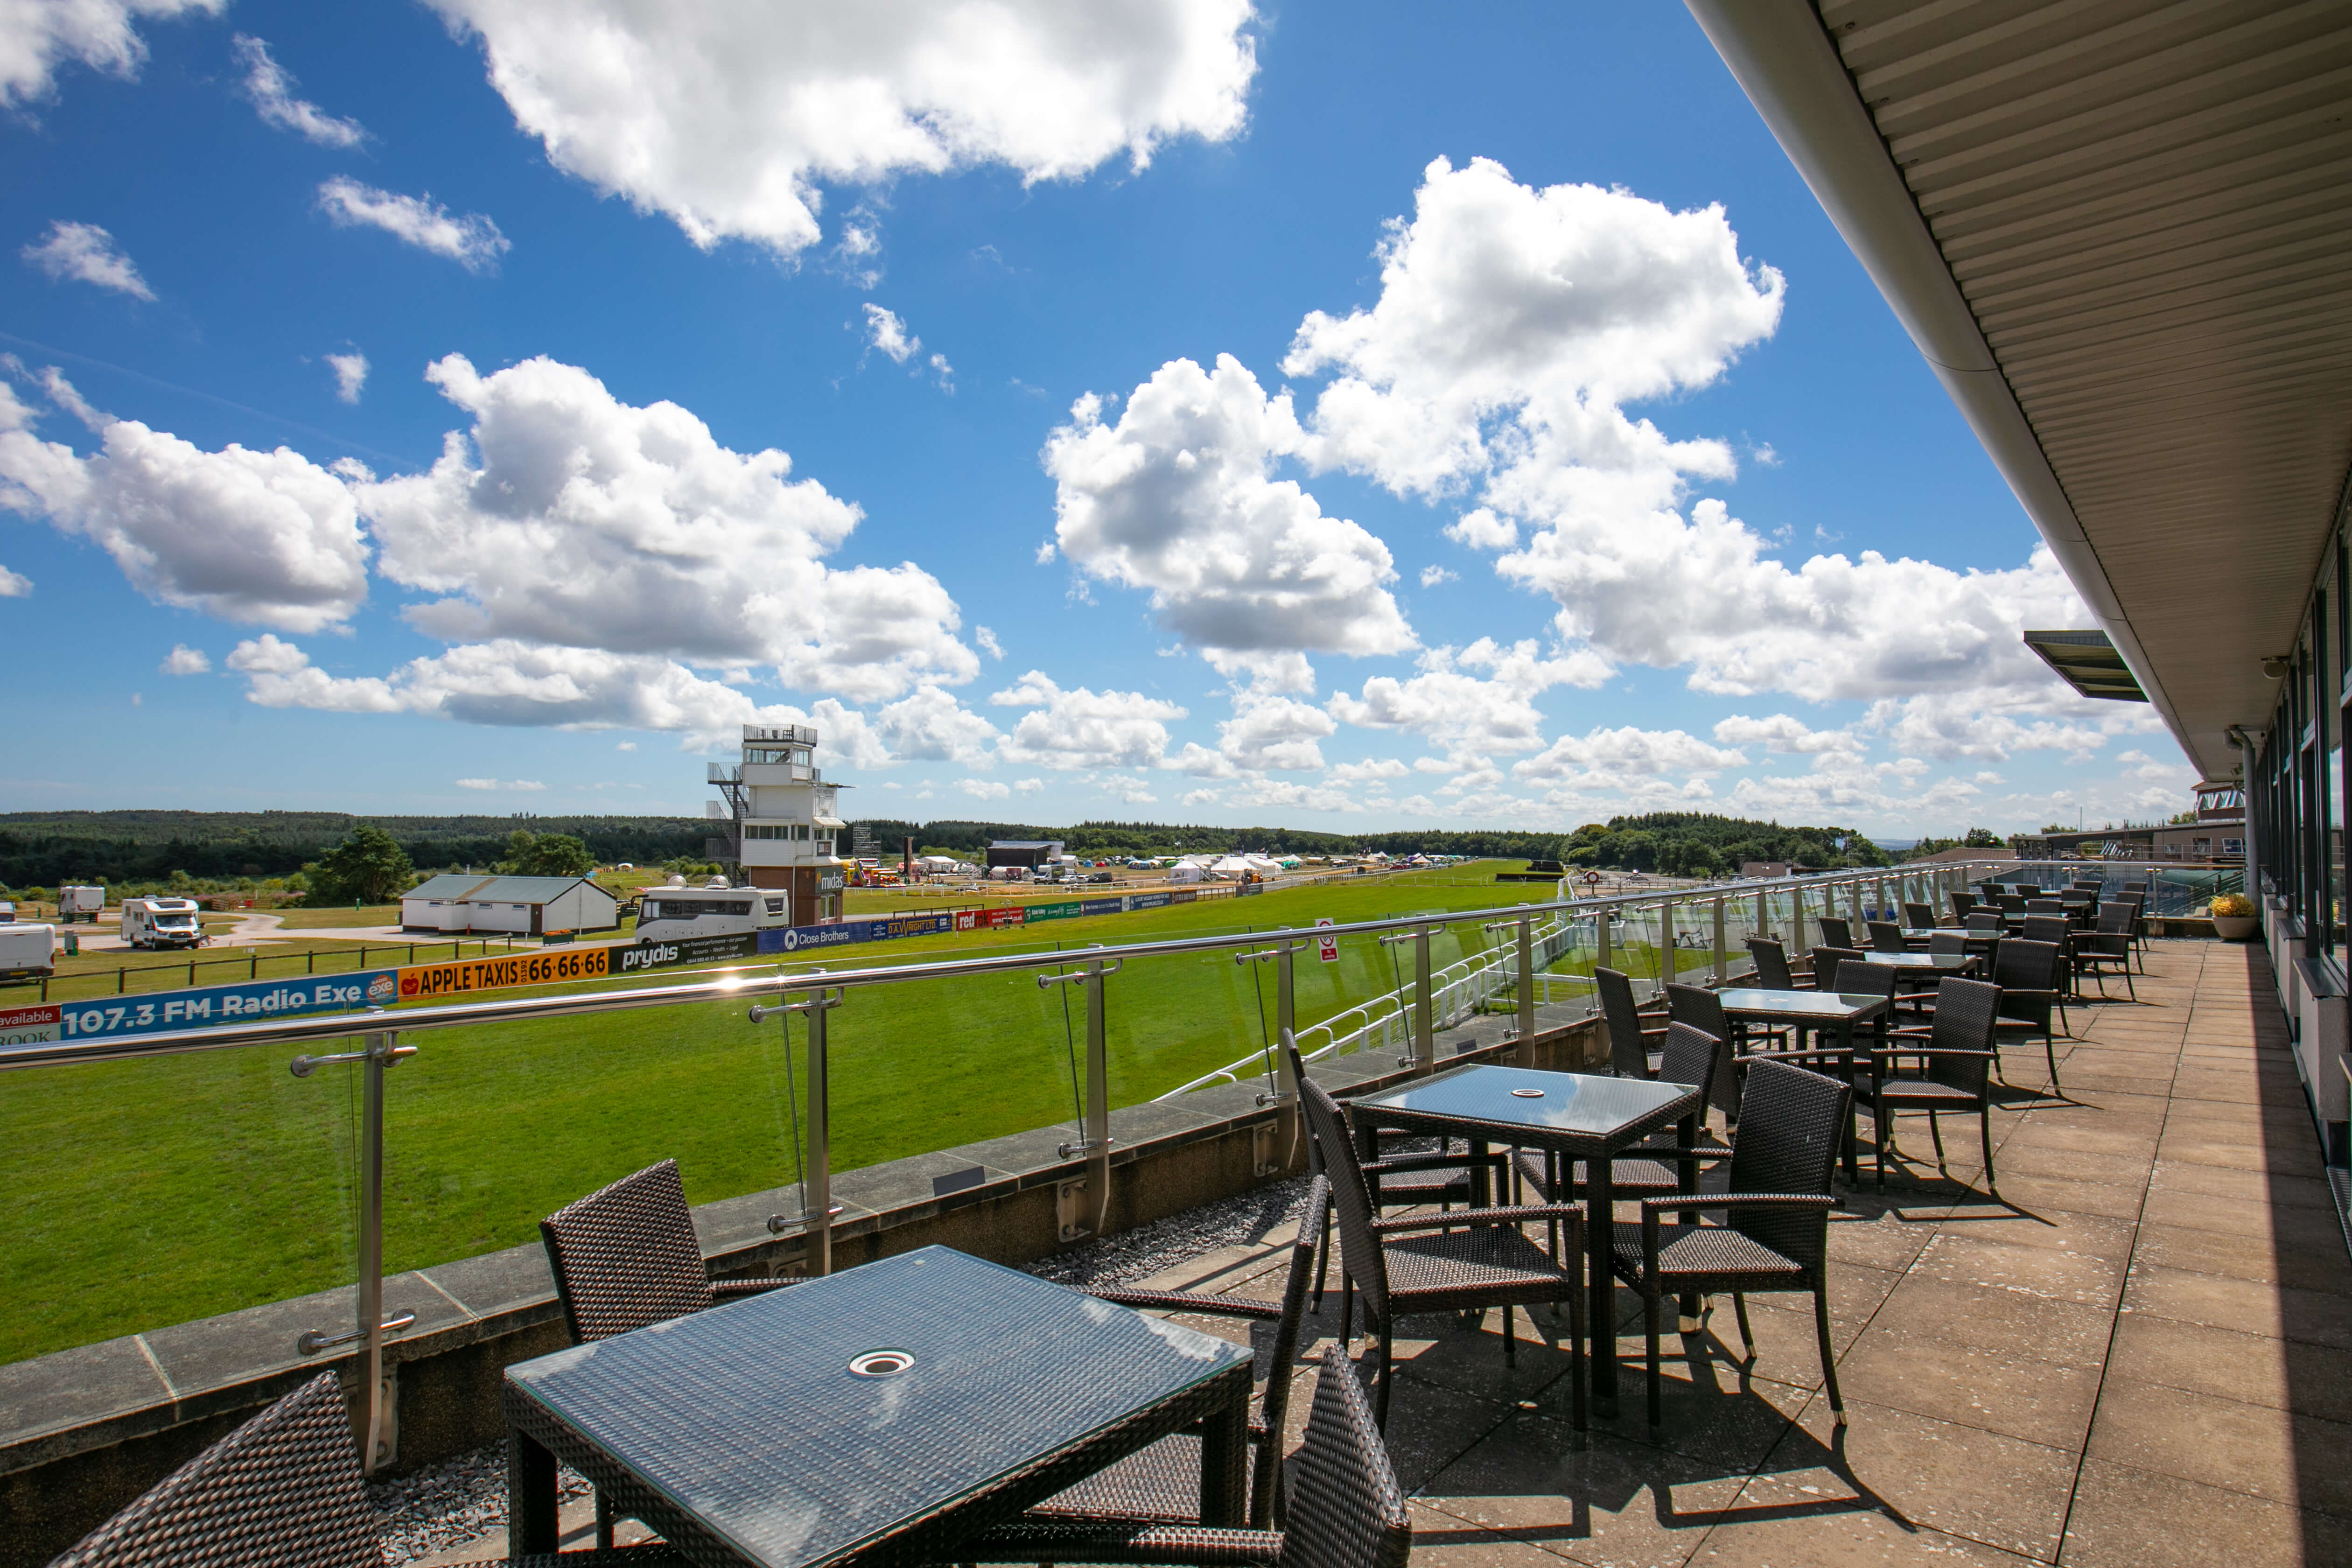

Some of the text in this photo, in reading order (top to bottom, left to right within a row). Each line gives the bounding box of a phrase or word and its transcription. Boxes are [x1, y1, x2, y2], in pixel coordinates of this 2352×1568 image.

[821, 871, 843, 889] midas
[926, 921, 937, 930] LTD.
[959, 911, 988, 929] redrok
[799, 931, 849, 945] Close Brothers
[622, 943, 679, 971] prydis
[420, 960, 518, 994] APPLE TAXIS
[368, 981, 393, 996] exe
[0, 1010, 53, 1026] available
[63, 984, 362, 1035] 107.3 FM Radio Exe
